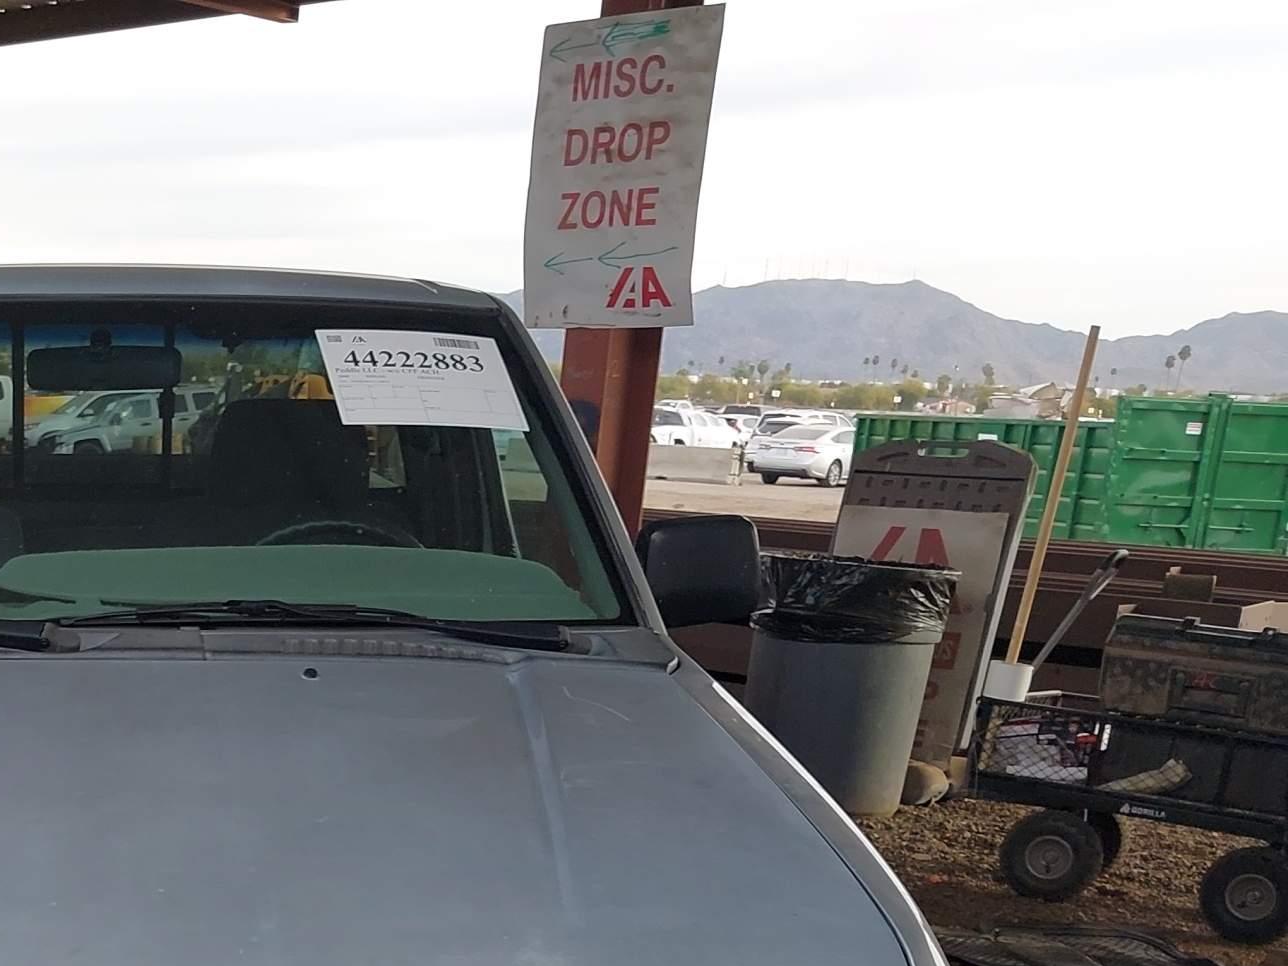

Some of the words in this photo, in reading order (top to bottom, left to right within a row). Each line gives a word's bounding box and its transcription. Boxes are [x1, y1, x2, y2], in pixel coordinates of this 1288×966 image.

[572, 54, 674, 102] MISC.
[563, 120, 671, 167] DROP
[557, 187, 660, 230] ZONE
[343, 350, 484, 373] 44222883
